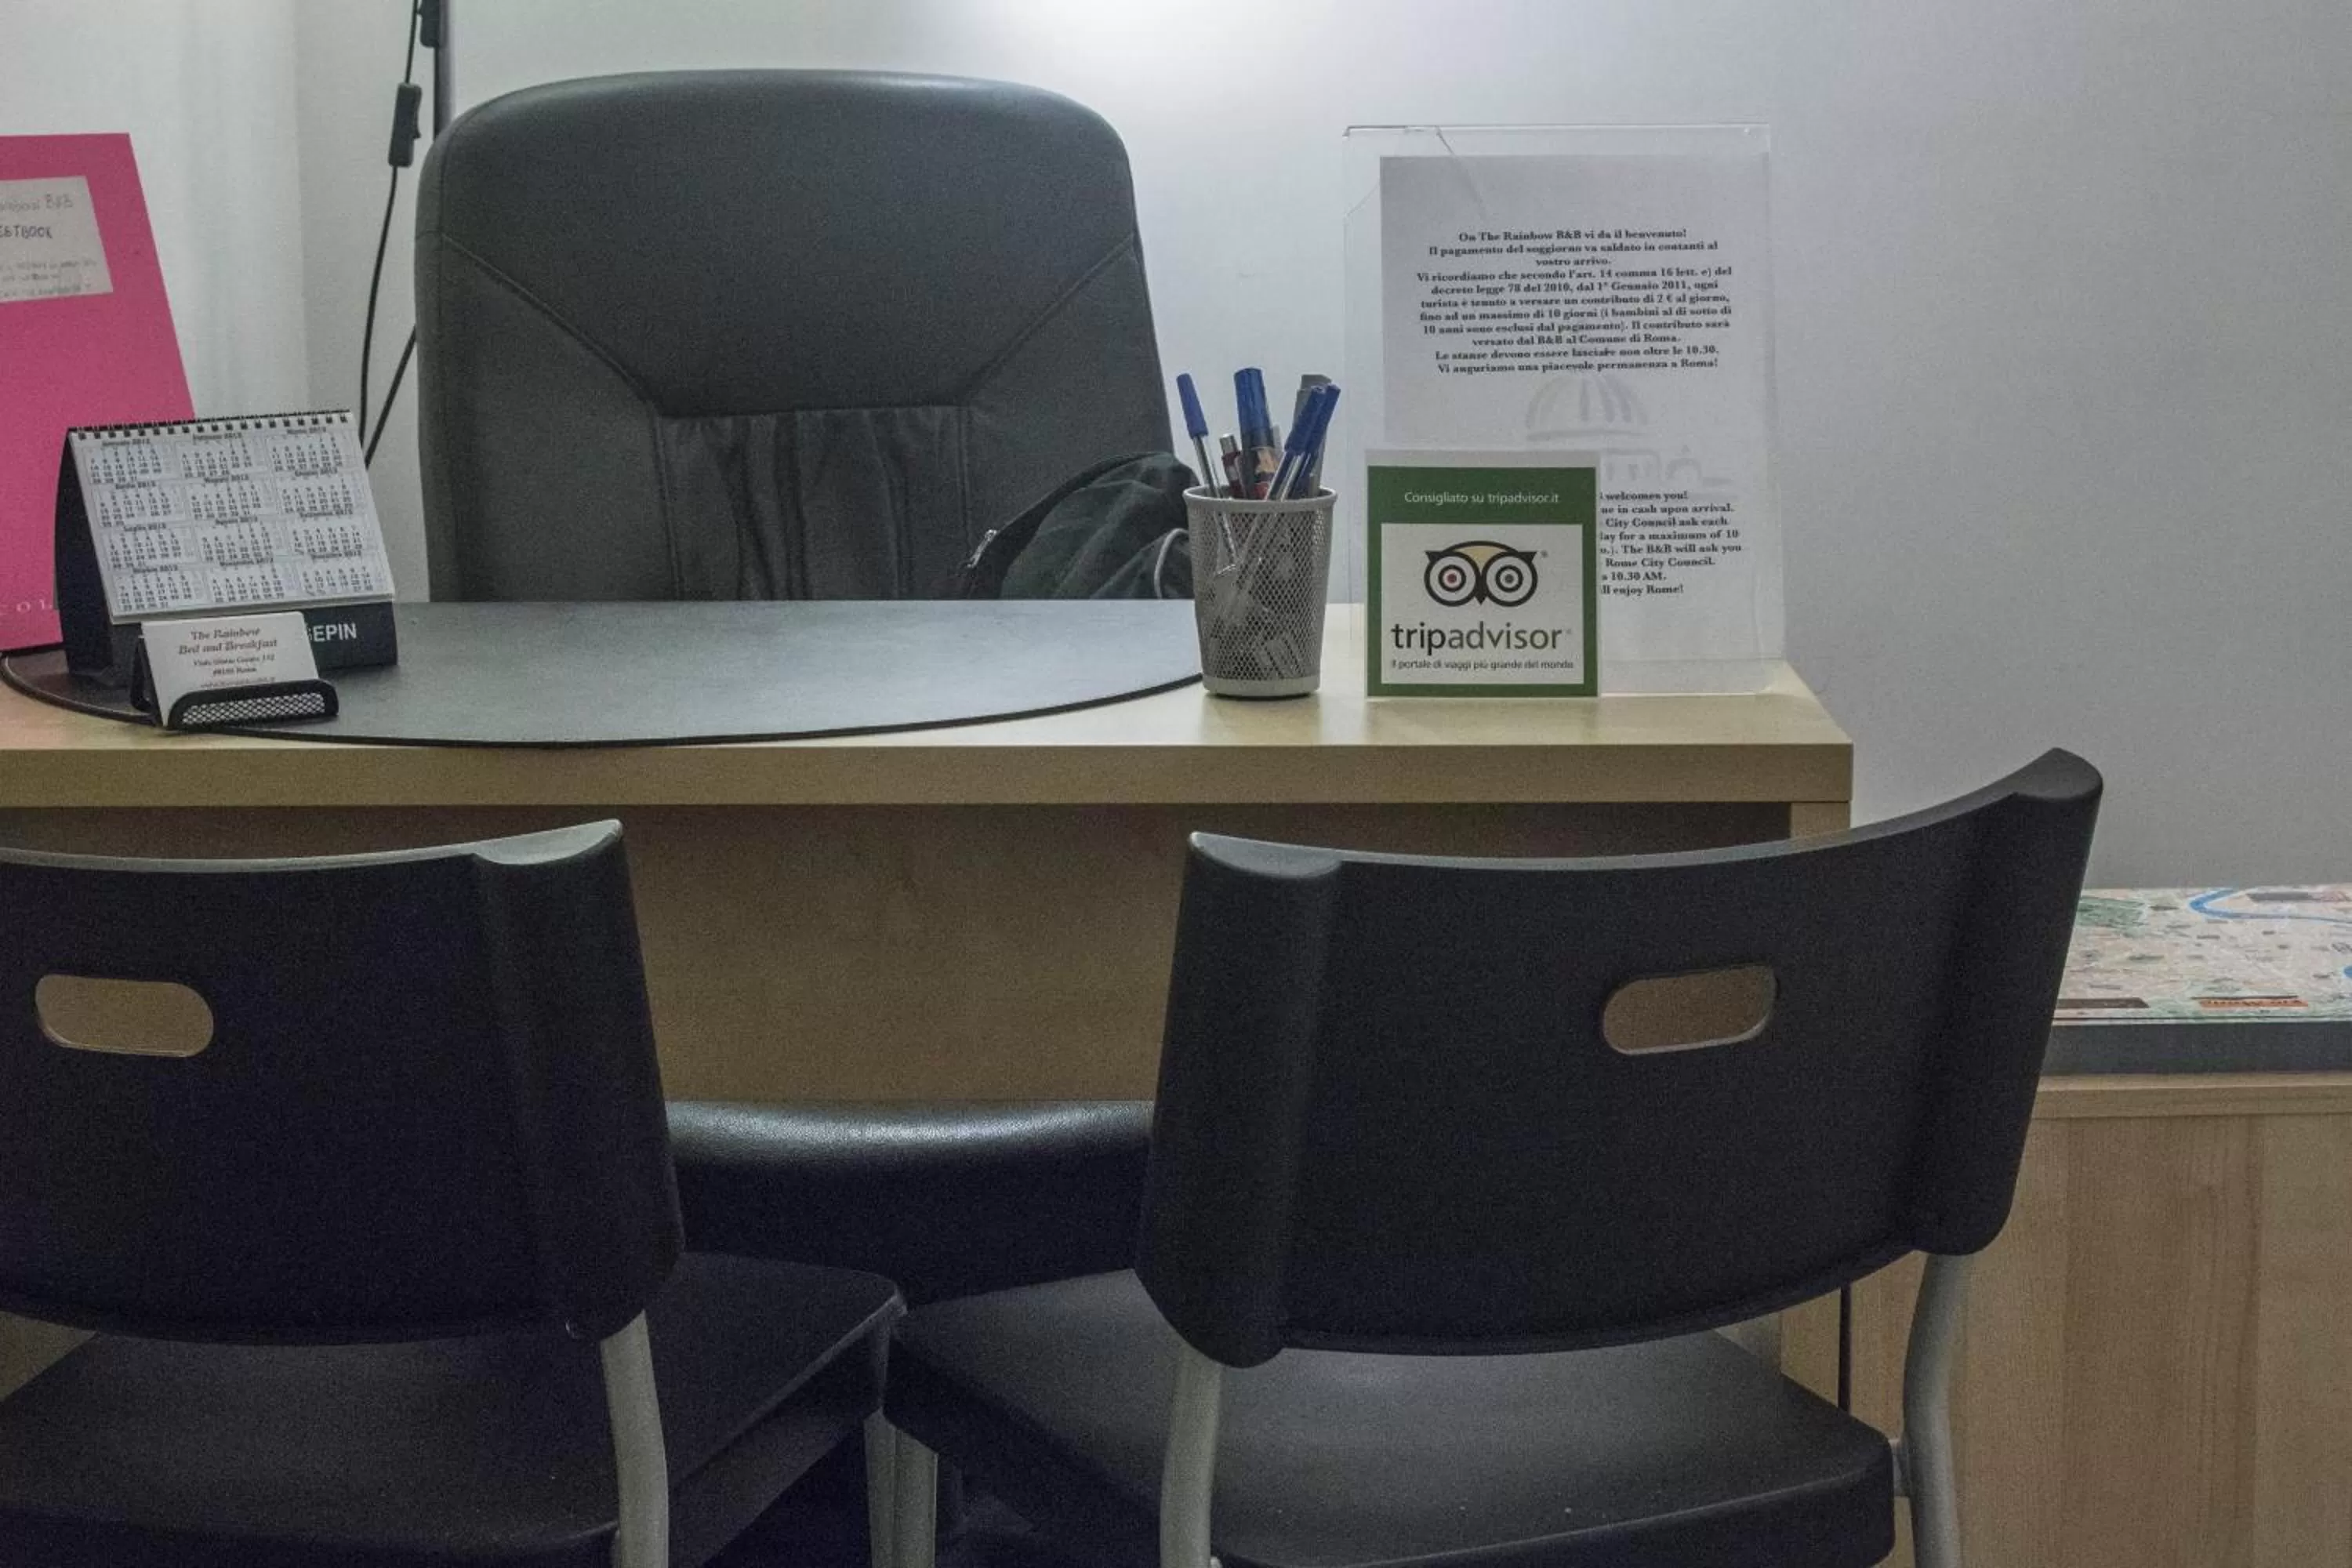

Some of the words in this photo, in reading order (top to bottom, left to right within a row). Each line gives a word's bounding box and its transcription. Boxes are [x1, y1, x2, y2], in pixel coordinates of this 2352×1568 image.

[1459, 232, 1476, 241] On
[1479, 232, 1501, 241] The
[1503, 231, 1552, 241] Rainbow
[1555, 230, 1581, 239] B&B
[1584, 230, 1595, 239] vi
[1614, 229, 1622, 238] il
[1624, 229, 1686, 238] benvenuto!
[1429, 246, 1438, 256] Il
[1440, 247, 1503, 257] pagamento
[1506, 245, 1524, 253] del
[1526, 244, 1582, 255] soggiorno
[1600, 242, 1642, 252] saldato
[1644, 242, 1655, 251] in
[1658, 241, 1704, 251] contanti
[1707, 241, 1718, 250] al
[1573, 256, 1611, 266] arrivo.
[1417, 273, 1429, 282] Vi
[1432, 271, 1496, 281] ricordiamo
[1498, 270, 1518, 279] che
[1520, 270, 1566, 280] secondo
[1600, 269, 1612, 278] 14
[1661, 267, 1673, 277] 16
[1715, 267, 1732, 277] del
[1431, 285, 1474, 296] decreto
[1475, 285, 1505, 295] legge
[1508, 283, 1521, 293] 78
[1523, 283, 1541, 292] del
[1576, 282, 1594, 292] dal
[1610, 281, 1659, 291] Gennaio
[1693, 280, 1718, 291] ogni
[1421, 299, 1459, 308] turista
[1581, 295, 1641, 304] contributo
[1642, 294, 1654, 303] di
[1657, 294, 1664, 303] 2
[1666, 294, 1672, 303] €
[1675, 294, 1686, 303] al
[1444, 311, 1458, 321] ad
[1479, 310, 1530, 320] massimo
[1533, 309, 1544, 318] di
[1548, 309, 1561, 318] 10
[1563, 308, 1598, 320] giorni
[1611, 307, 1660, 317] bambini
[1662, 307, 1674, 316] al
[1675, 307, 1687, 316] di
[1719, 306, 1731, 315] di
[1424, 325, 1436, 334] 10
[1439, 325, 1464, 334] anni
[1495, 323, 1534, 333] esclusi
[1536, 322, 1555, 332] dal
[1632, 321, 1640, 329] Il
[1642, 320, 1703, 330] contributo
[1516, 336, 1535, 345] dal
[1537, 335, 1563, 345] B&B
[1566, 336, 1577, 344] al
[1579, 335, 1626, 343] Comune
[1629, 333, 1641, 343] di
[1436, 351, 1449, 360] Le
[1490, 350, 1530, 359] devono
[1534, 348, 1569, 358] essere
[1642, 347, 1670, 355] oltre
[1672, 346, 1683, 355] le
[1438, 364, 1450, 373] Vi
[1453, 364, 1515, 374] auguriamo
[1541, 361, 1595, 372] piacevole
[1597, 361, 1668, 372] permanenza
[1680, 358, 1718, 369] Roma!
[1404, 491, 1468, 506] Consigliato
[1471, 493, 1484, 503] su
[1488, 491, 1559, 506] tripadvisor.it
[1606, 491, 1661, 502] welcomes
[1663, 491, 1690, 502] you!
[1617, 505, 1628, 514] in
[1632, 504, 1657, 514] cash
[1660, 506, 1689, 516] upon
[1606, 517, 1629, 529] City
[1631, 517, 1677, 528] Council
[1679, 517, 1700, 527] ask
[1701, 516, 1729, 526] each
[1619, 531, 1636, 541] for
[1649, 530, 1707, 540] maximum
[1710, 529, 1722, 539] of
[1621, 544, 1643, 554] The
[1646, 543, 1672, 554] B&B
[1674, 543, 1696, 553] will
[1698, 543, 1719, 552] ask
[1722, 545, 1741, 555] you
[1606, 558, 1637, 568] Rome
[1641, 557, 1664, 568] City
[1611, 572, 1641, 581] 10.30
[1613, 585, 1643, 596] enjoy
[1646, 583, 1683, 594] Rome!
[191, 630, 210, 641] The
[1391, 620, 1563, 655] tripadvisor
[179, 644, 200, 655] Bed
